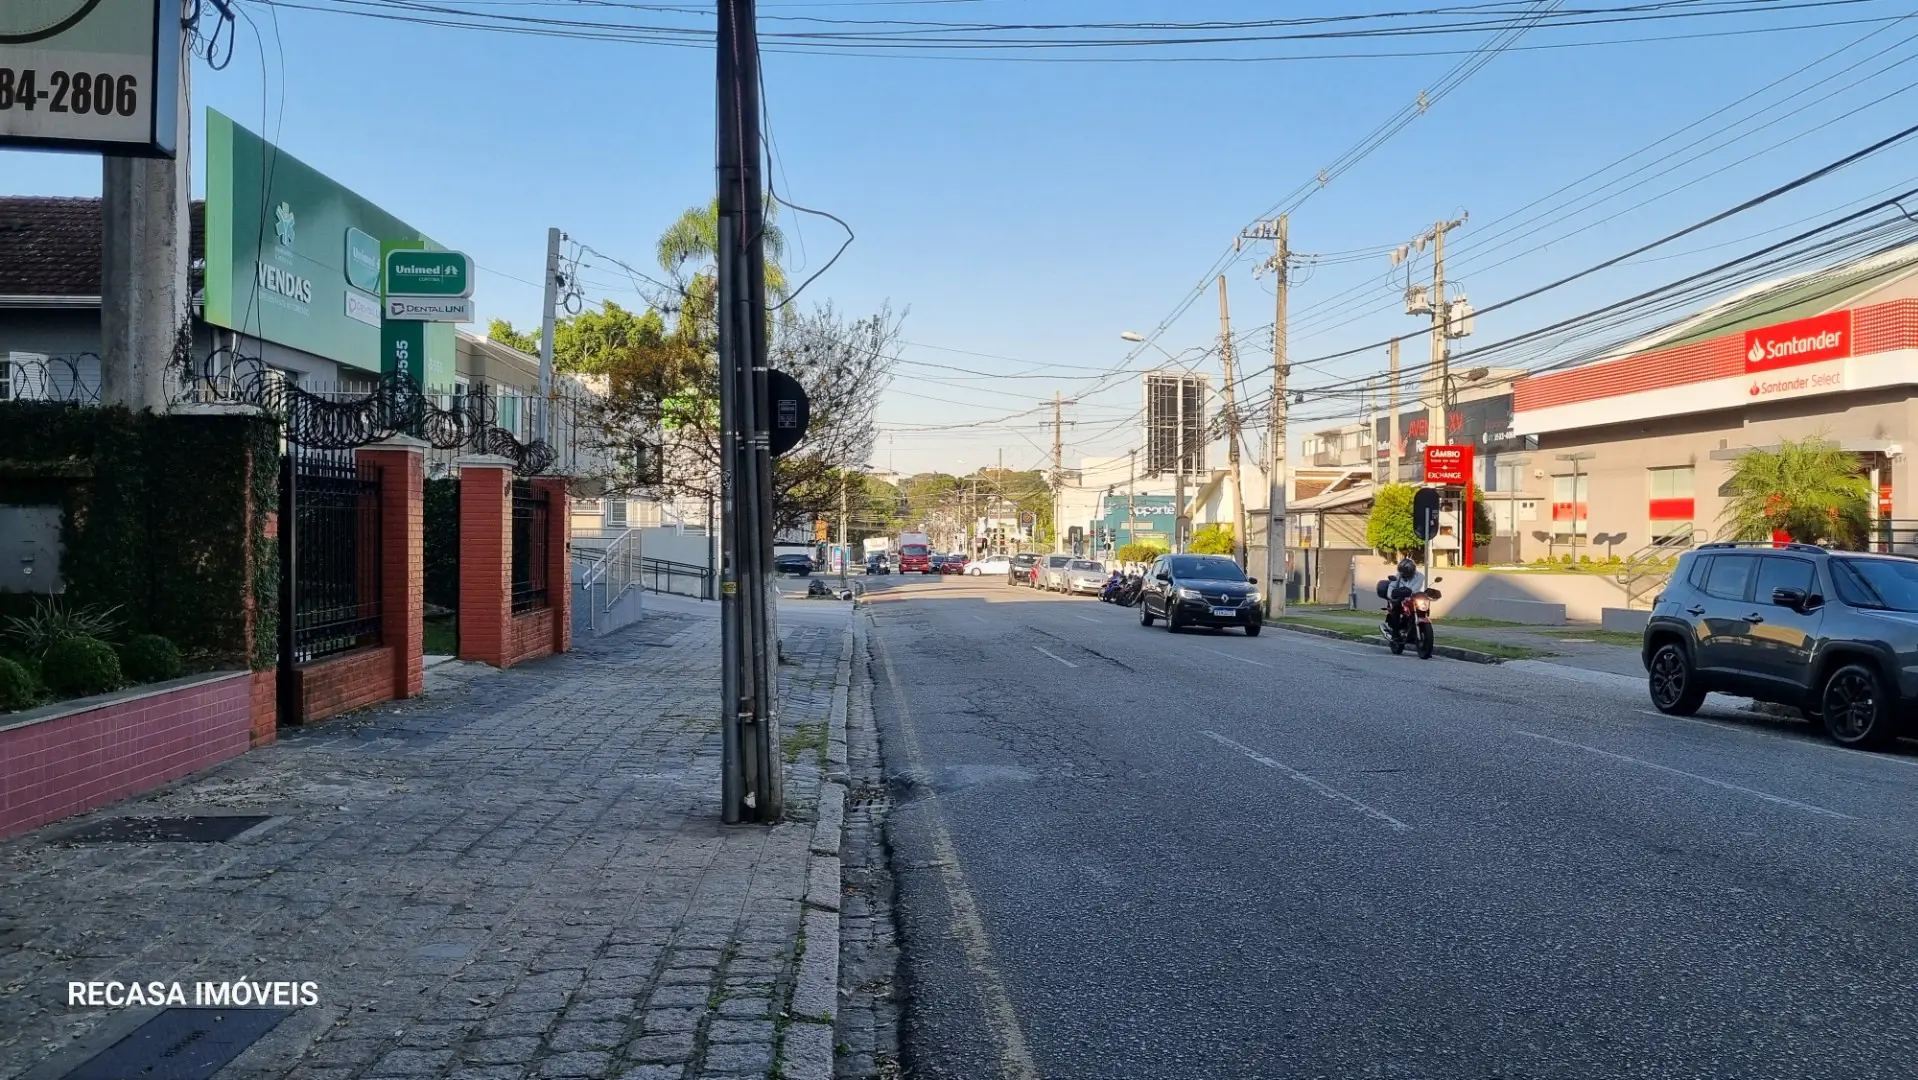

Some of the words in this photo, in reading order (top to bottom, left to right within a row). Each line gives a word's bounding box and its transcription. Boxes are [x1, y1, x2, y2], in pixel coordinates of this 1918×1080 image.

[395, 265, 440, 275] Unimed
[258, 261, 311, 304] VENDAS
[1766, 330, 1843, 359] Santander
[1761, 376, 1809, 395] Santander
[1811, 371, 1841, 388] Select
[1430, 449, 1461, 458] CÂMBIO
